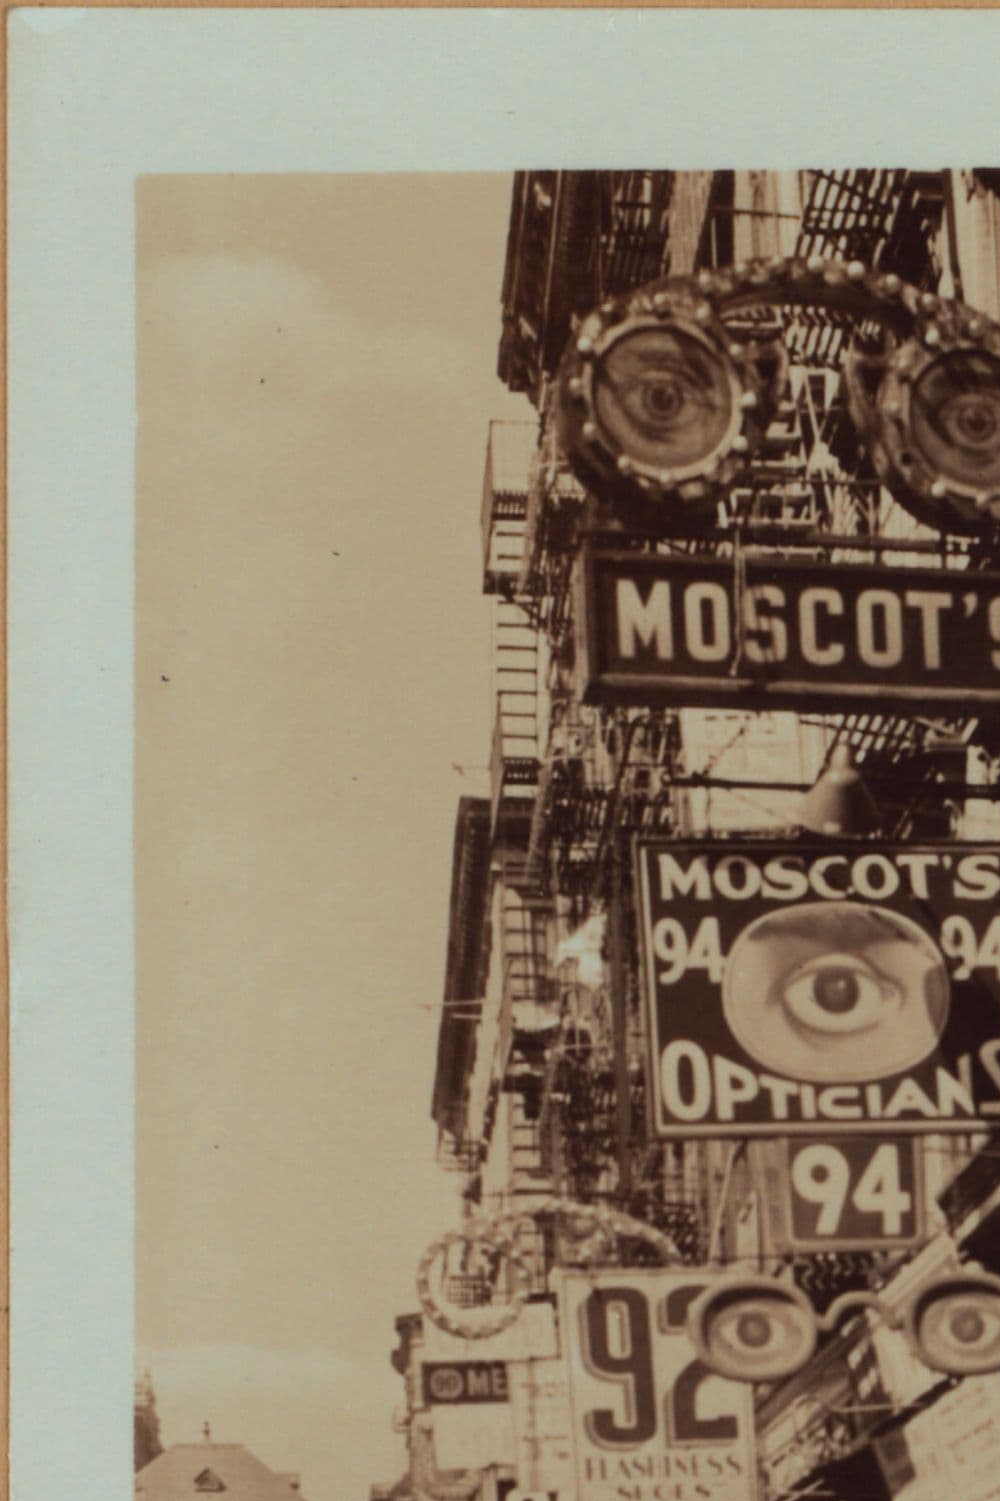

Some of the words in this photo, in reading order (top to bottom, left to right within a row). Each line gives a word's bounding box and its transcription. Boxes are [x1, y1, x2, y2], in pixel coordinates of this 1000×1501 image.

[654, 916, 727, 985] 94
[792, 1143, 911, 1236] 94
[577, 1285, 740, 1450] 92
